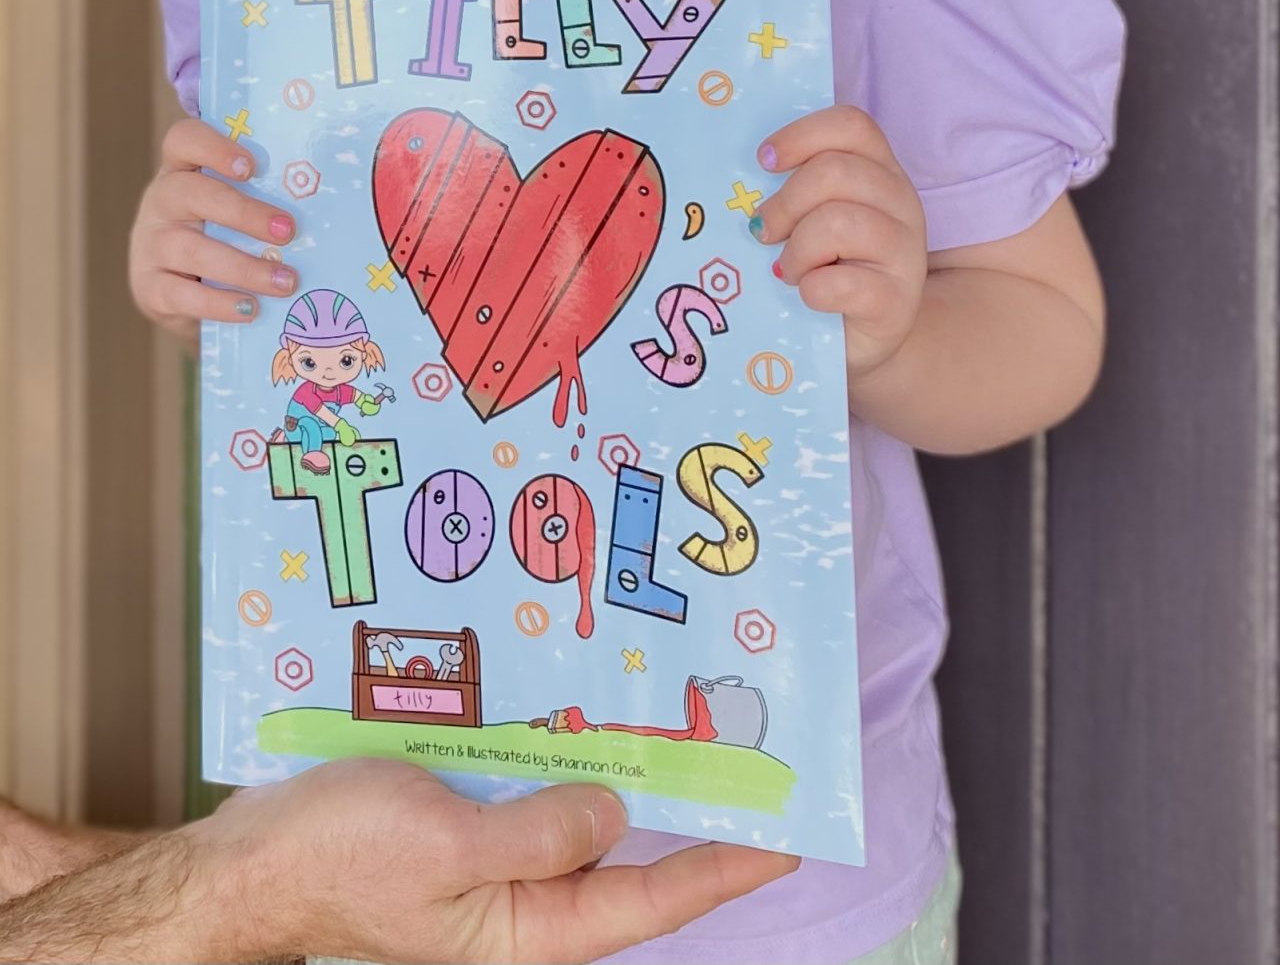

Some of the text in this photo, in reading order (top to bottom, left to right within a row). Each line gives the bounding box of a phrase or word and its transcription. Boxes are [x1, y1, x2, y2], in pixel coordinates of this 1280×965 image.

[265, 438, 766, 625] TOOLS
[393, 690, 432, 710] tilly
[456, 744, 464, 758] &
[533, 752, 548, 772] by
[551, 754, 609, 774] Shannon
[612, 761, 646, 778] Chalk
